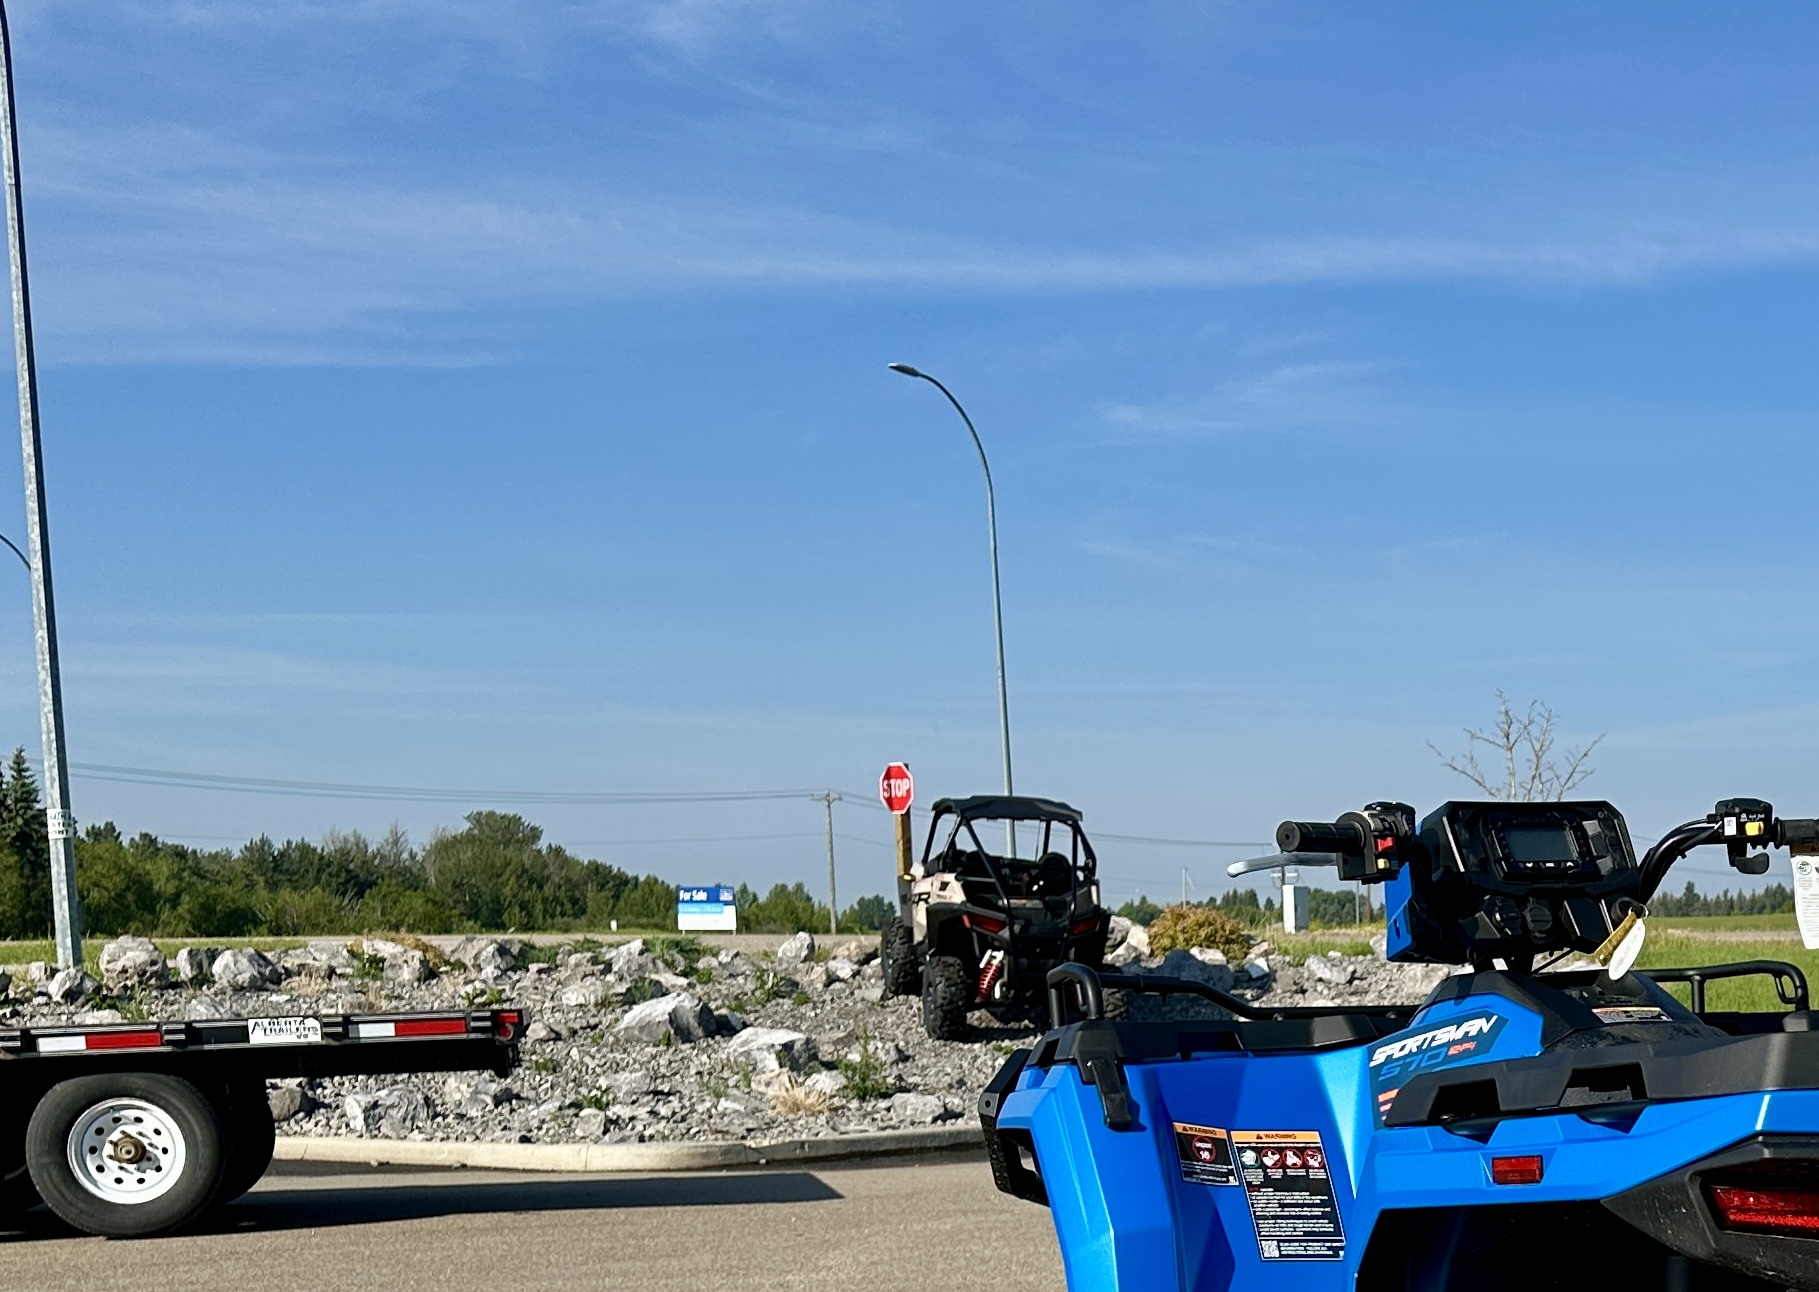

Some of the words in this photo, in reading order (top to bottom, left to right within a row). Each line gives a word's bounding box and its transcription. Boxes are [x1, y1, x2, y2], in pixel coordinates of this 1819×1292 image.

[883, 778, 910, 798] STOP
[1369, 1015, 1498, 1067] SPORTSMAN
[1378, 1047, 1447, 1081] 570
